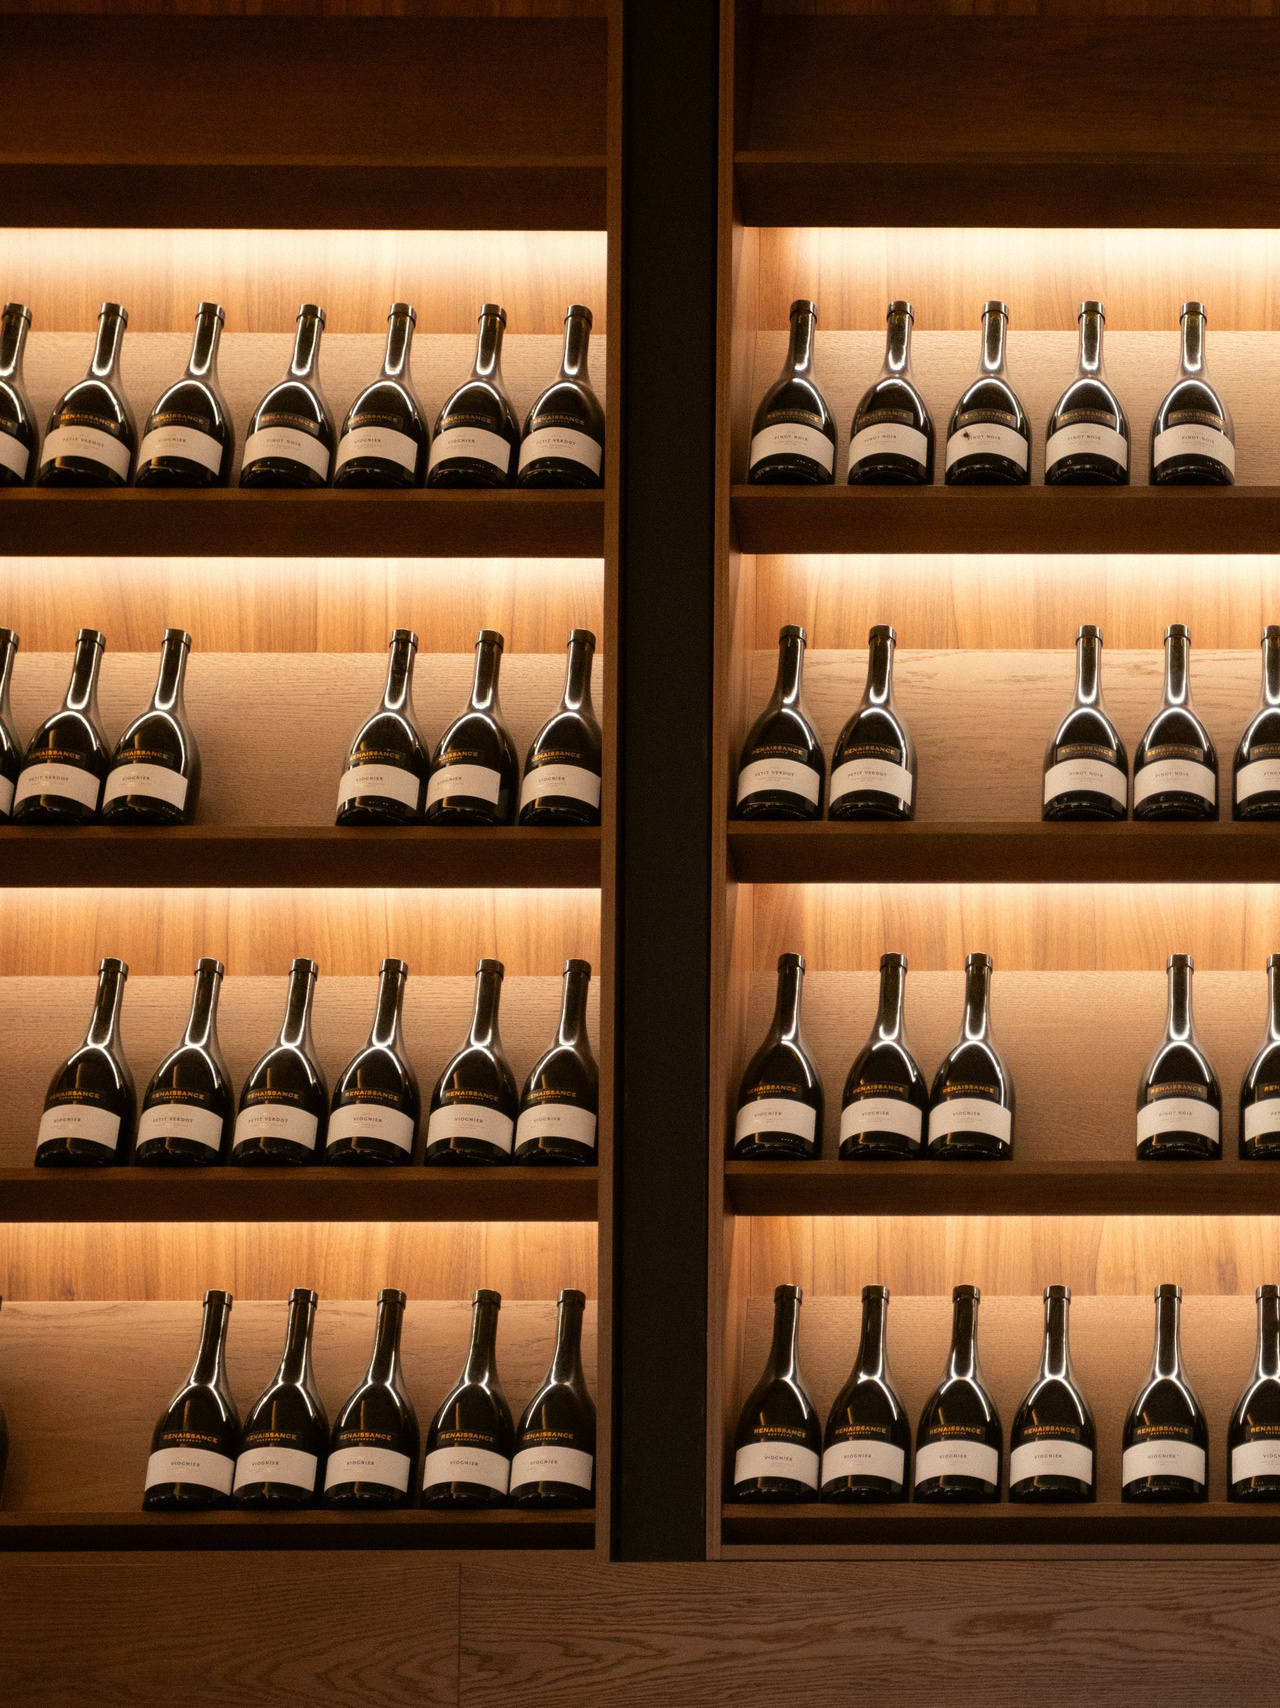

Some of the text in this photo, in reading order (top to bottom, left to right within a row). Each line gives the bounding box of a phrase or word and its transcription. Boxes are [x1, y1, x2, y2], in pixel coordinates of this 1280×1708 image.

[943, 1085, 995, 1093] RENAISSANCE
[1151, 1084, 1203, 1094] RENAISSANCE
[153, 1091, 205, 1099] RENAISSANCE
[248, 1091, 299, 1099] RENAISSANCE
[345, 1090, 399, 1101] RENAISSANCE
[446, 1091, 499, 1101] RENAISSANCE
[754, 1428, 806, 1438] RENAISSANCE
[835, 1426, 887, 1434] RENAISSANCE
[929, 1426, 981, 1434] RENAISSANCE
[1024, 1426, 1076, 1434] RENAISSANCE
[1136, 1426, 1189, 1434] RENAISSANCE
[164, 1433, 218, 1443] RENAISSANCE
[340, 1432, 392, 1440] RENAISSANCE
[442, 1433, 494, 1442] RENAISSANCE
